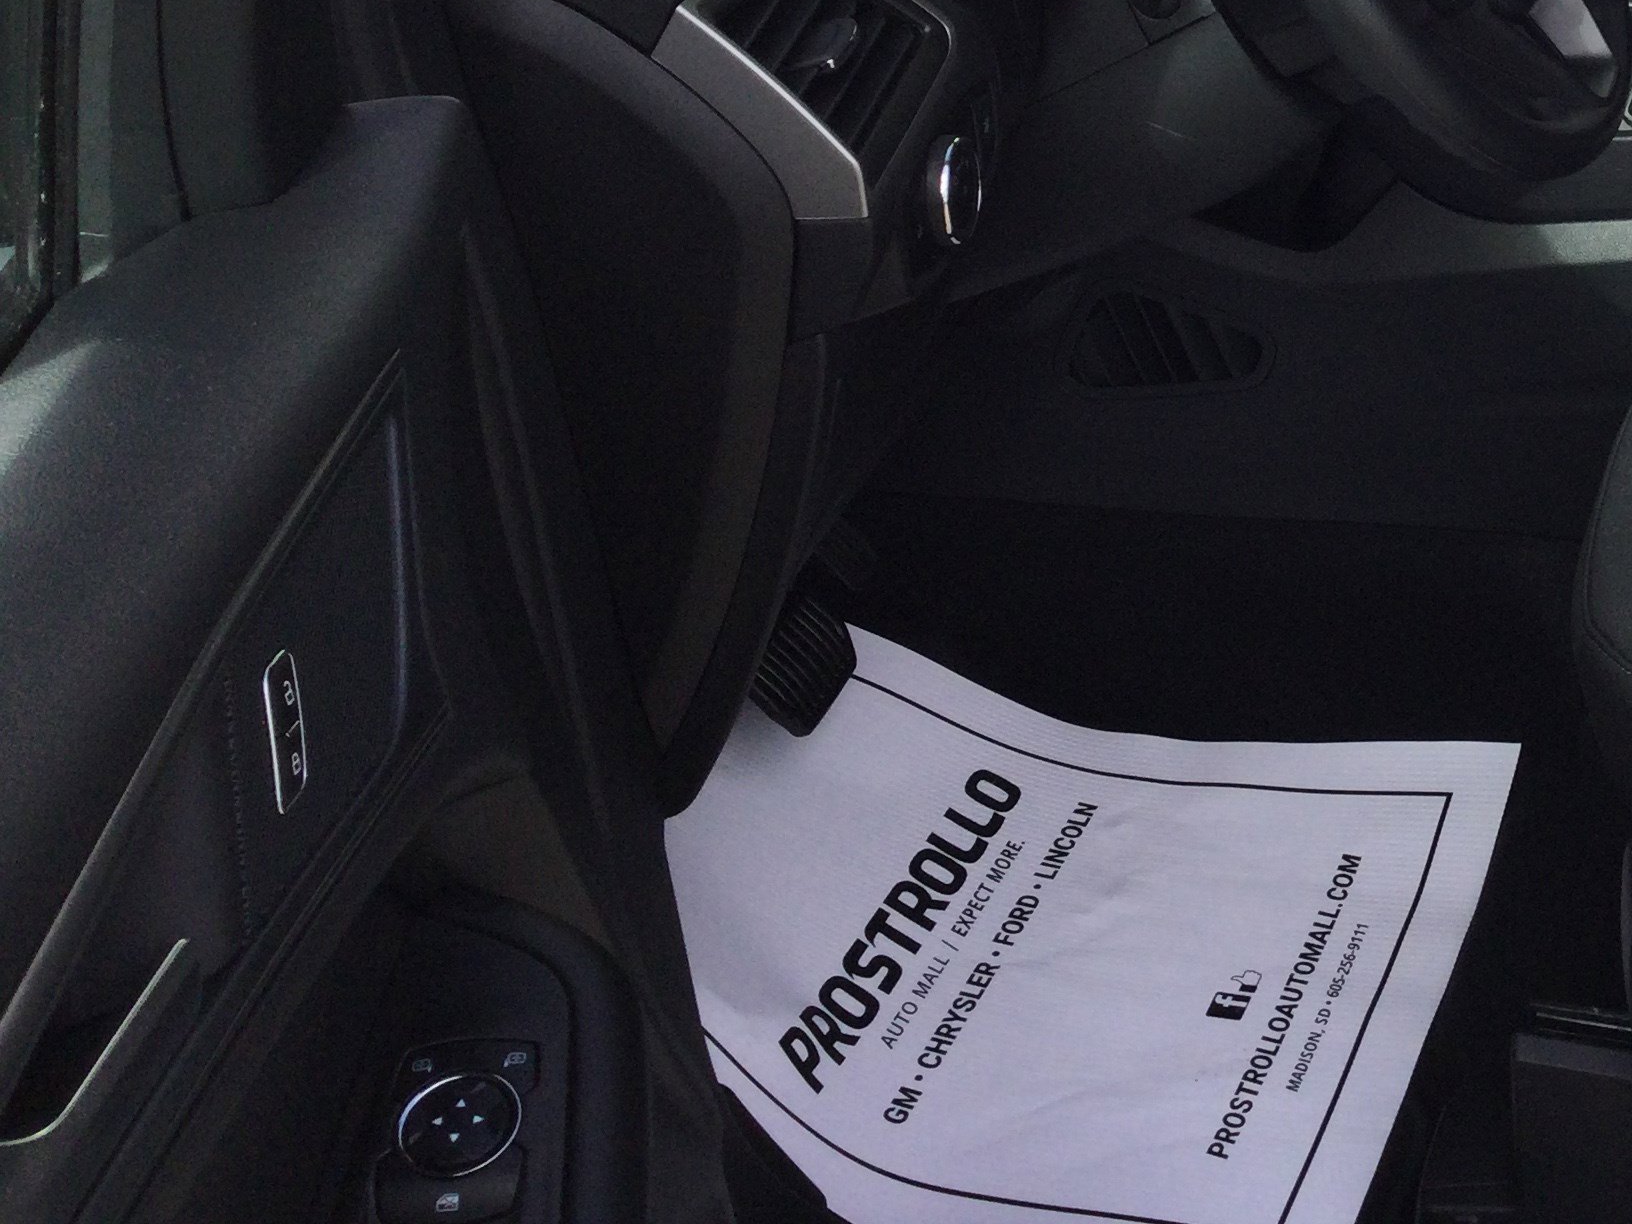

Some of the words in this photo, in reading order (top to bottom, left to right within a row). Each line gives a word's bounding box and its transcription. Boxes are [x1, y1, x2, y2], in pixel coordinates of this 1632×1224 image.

[777, 768, 1022, 1095] PROSTROLLO
[880, 1001, 919, 1050] AUTO
[911, 956, 950, 999] MALL
[950, 882, 995, 938] EXPECT
[985, 839, 1026, 884] MORE.
[883, 1085, 923, 1125] GM
[917, 961, 1001, 1069] CHRYSLER
[992, 894, 1040, 947] FORD
[1033, 801, 1099, 880] LINCOLN
[1205, 853, 1363, 1160] PROSTROLLOAUTOMALL.COM
[1285, 1029, 1326, 1093] MADISON,
[1314, 1007, 1332, 1025] SD
[1326, 923, 1369, 998] 605-256-9111
